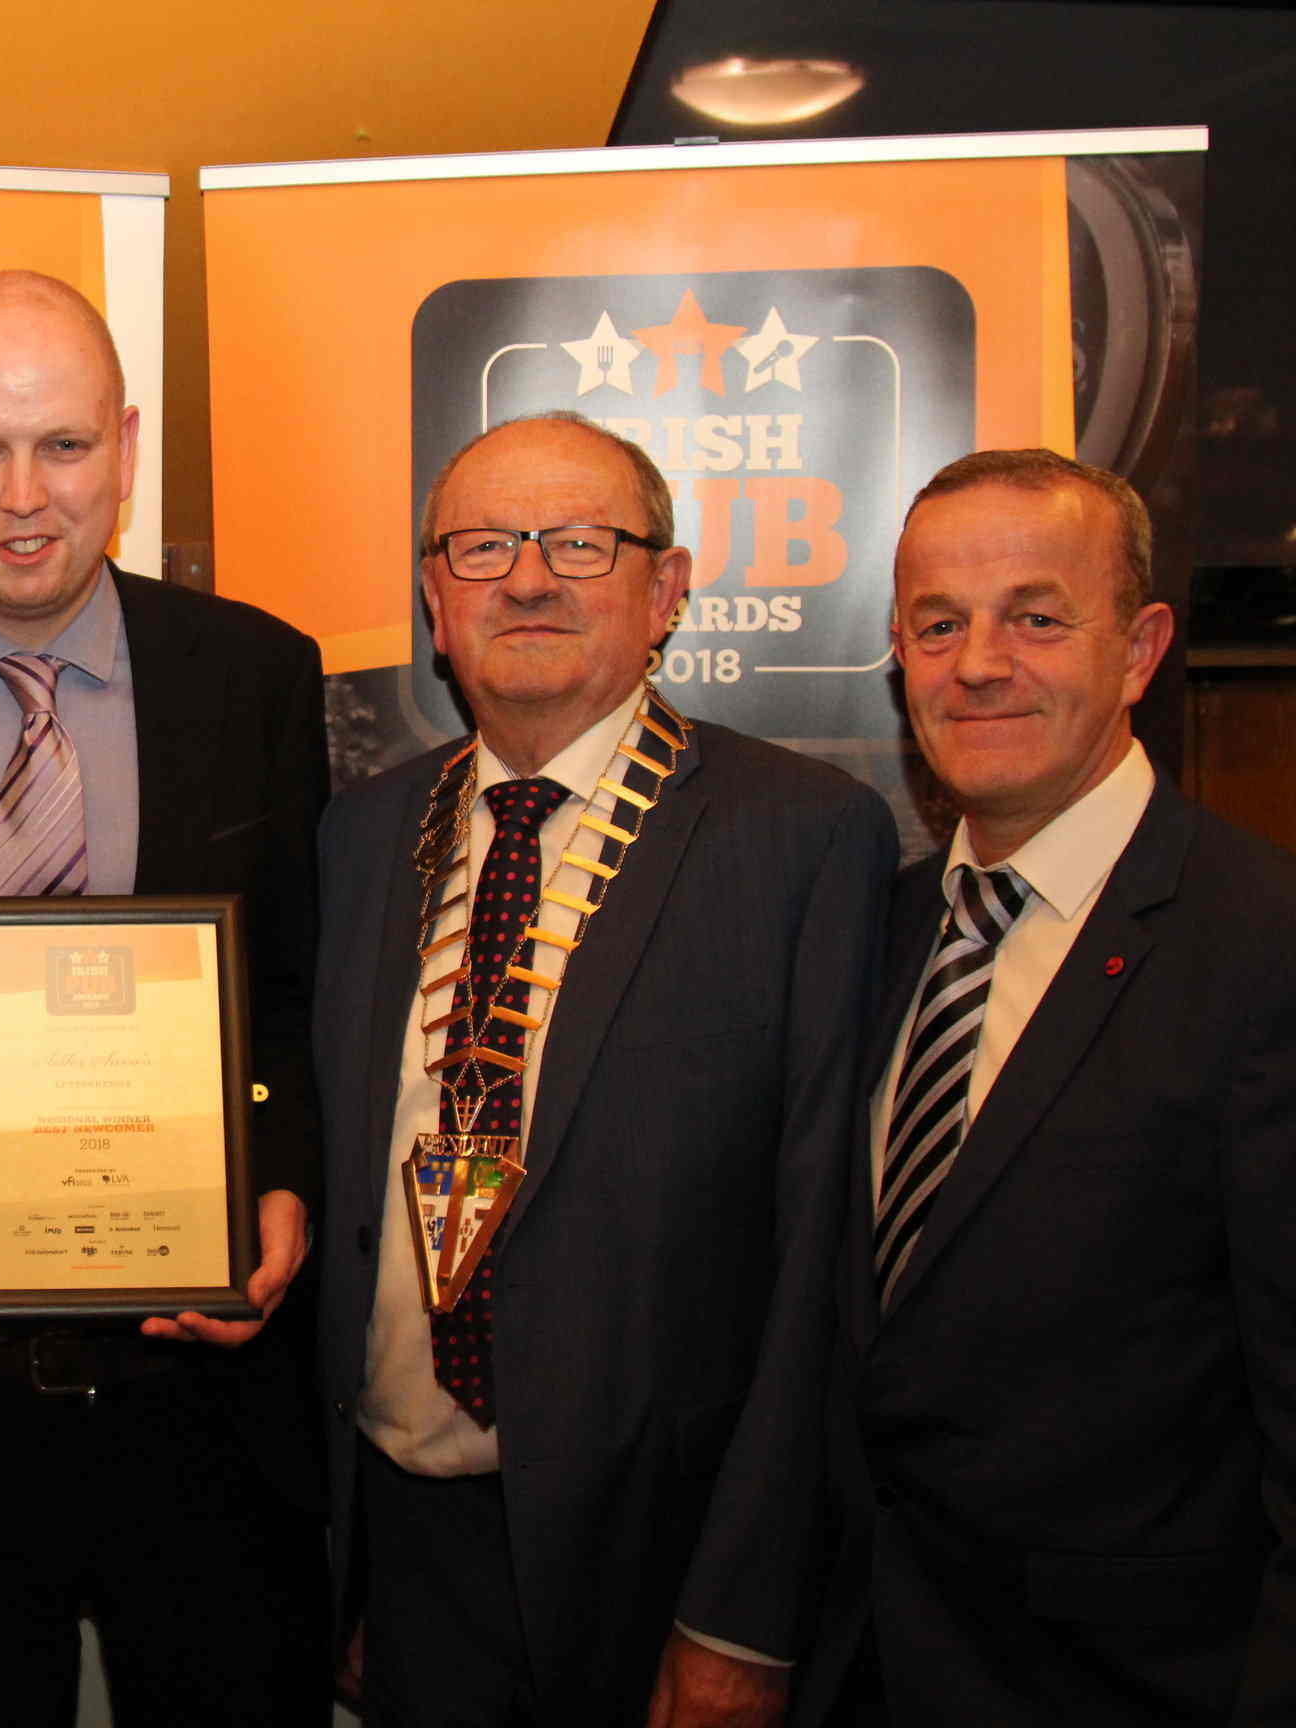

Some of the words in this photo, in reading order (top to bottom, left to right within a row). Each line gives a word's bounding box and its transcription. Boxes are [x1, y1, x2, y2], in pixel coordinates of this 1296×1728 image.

[590, 414, 802, 471] RISH
[661, 476, 849, 589] UB
[664, 594, 803, 633] ARDS
[646, 648, 742, 684] 2018
[79, 1137, 111, 1151] 2018
